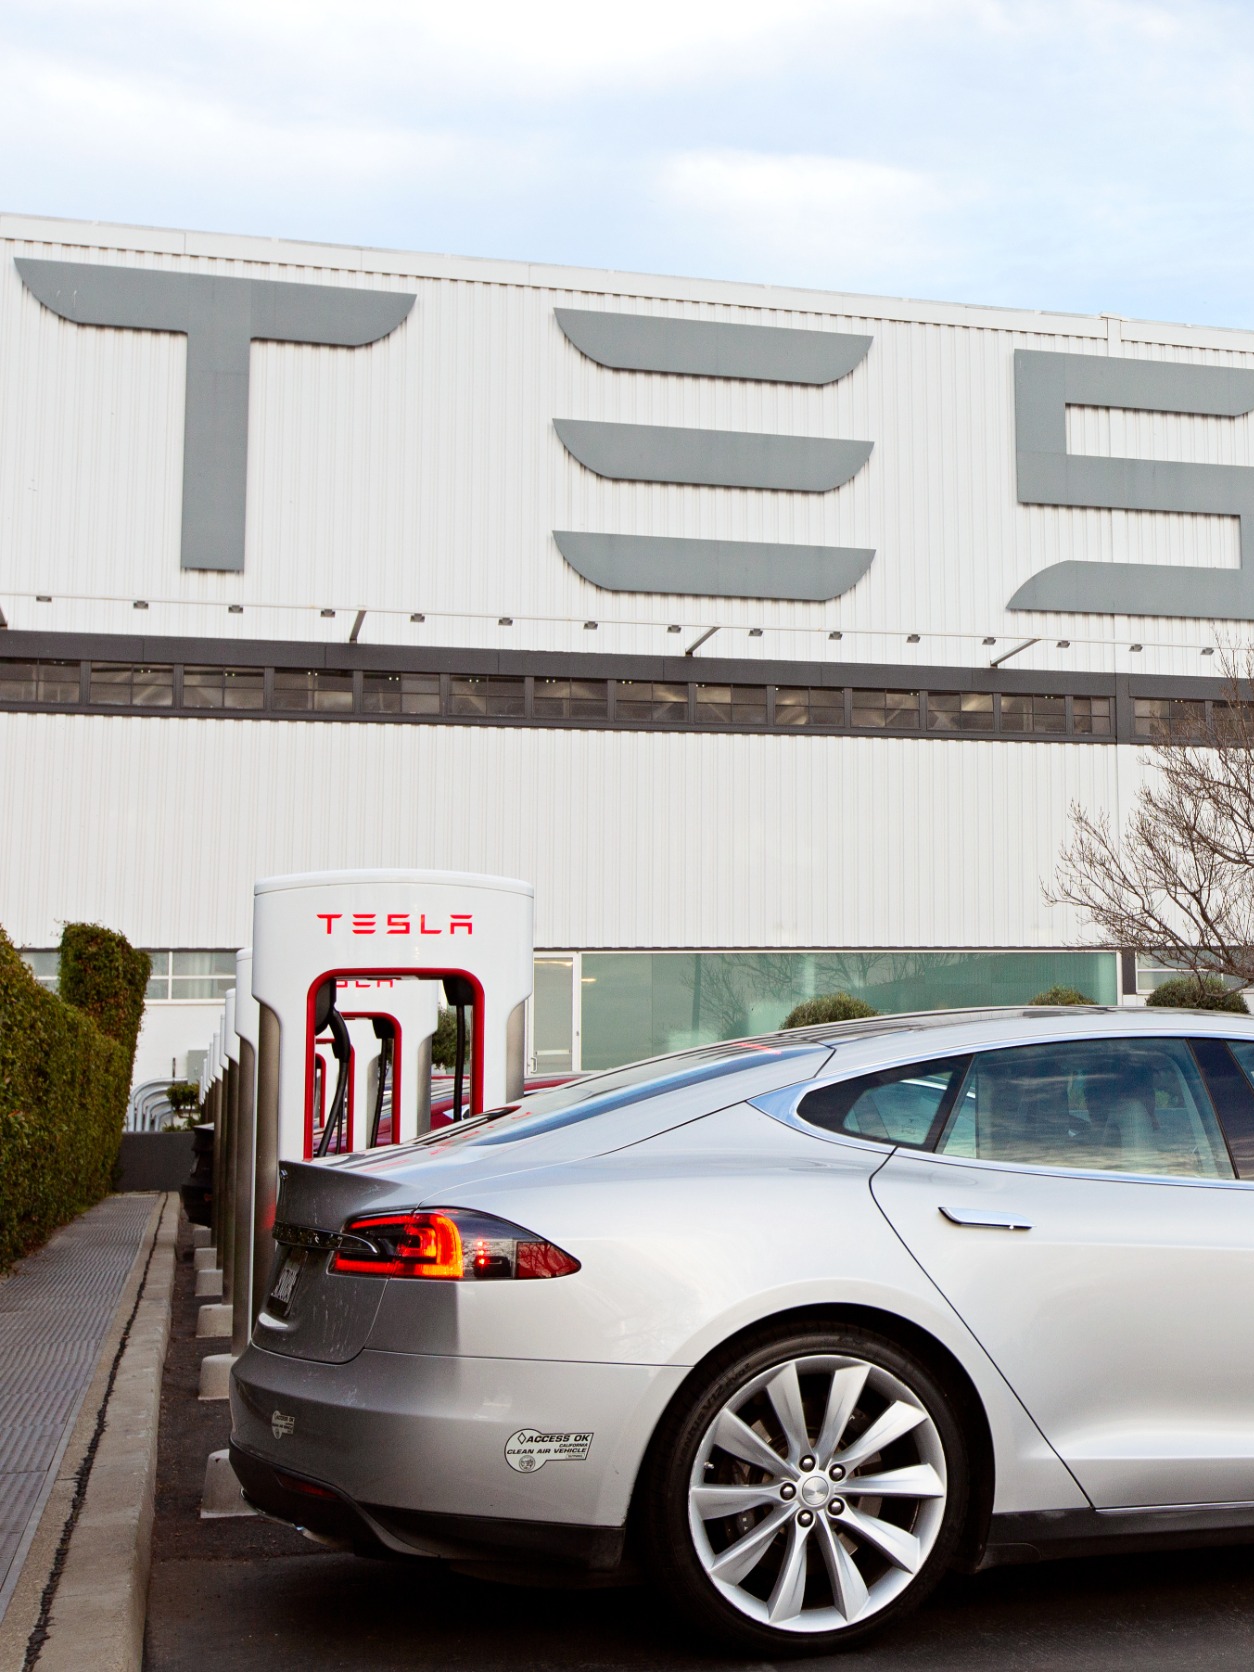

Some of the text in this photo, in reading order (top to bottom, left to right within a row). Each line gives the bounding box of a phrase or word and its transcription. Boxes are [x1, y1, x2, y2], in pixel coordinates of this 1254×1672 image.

[316, 913, 473, 935] TESLA
[526, 1434, 590, 1443] ACCESS OK
